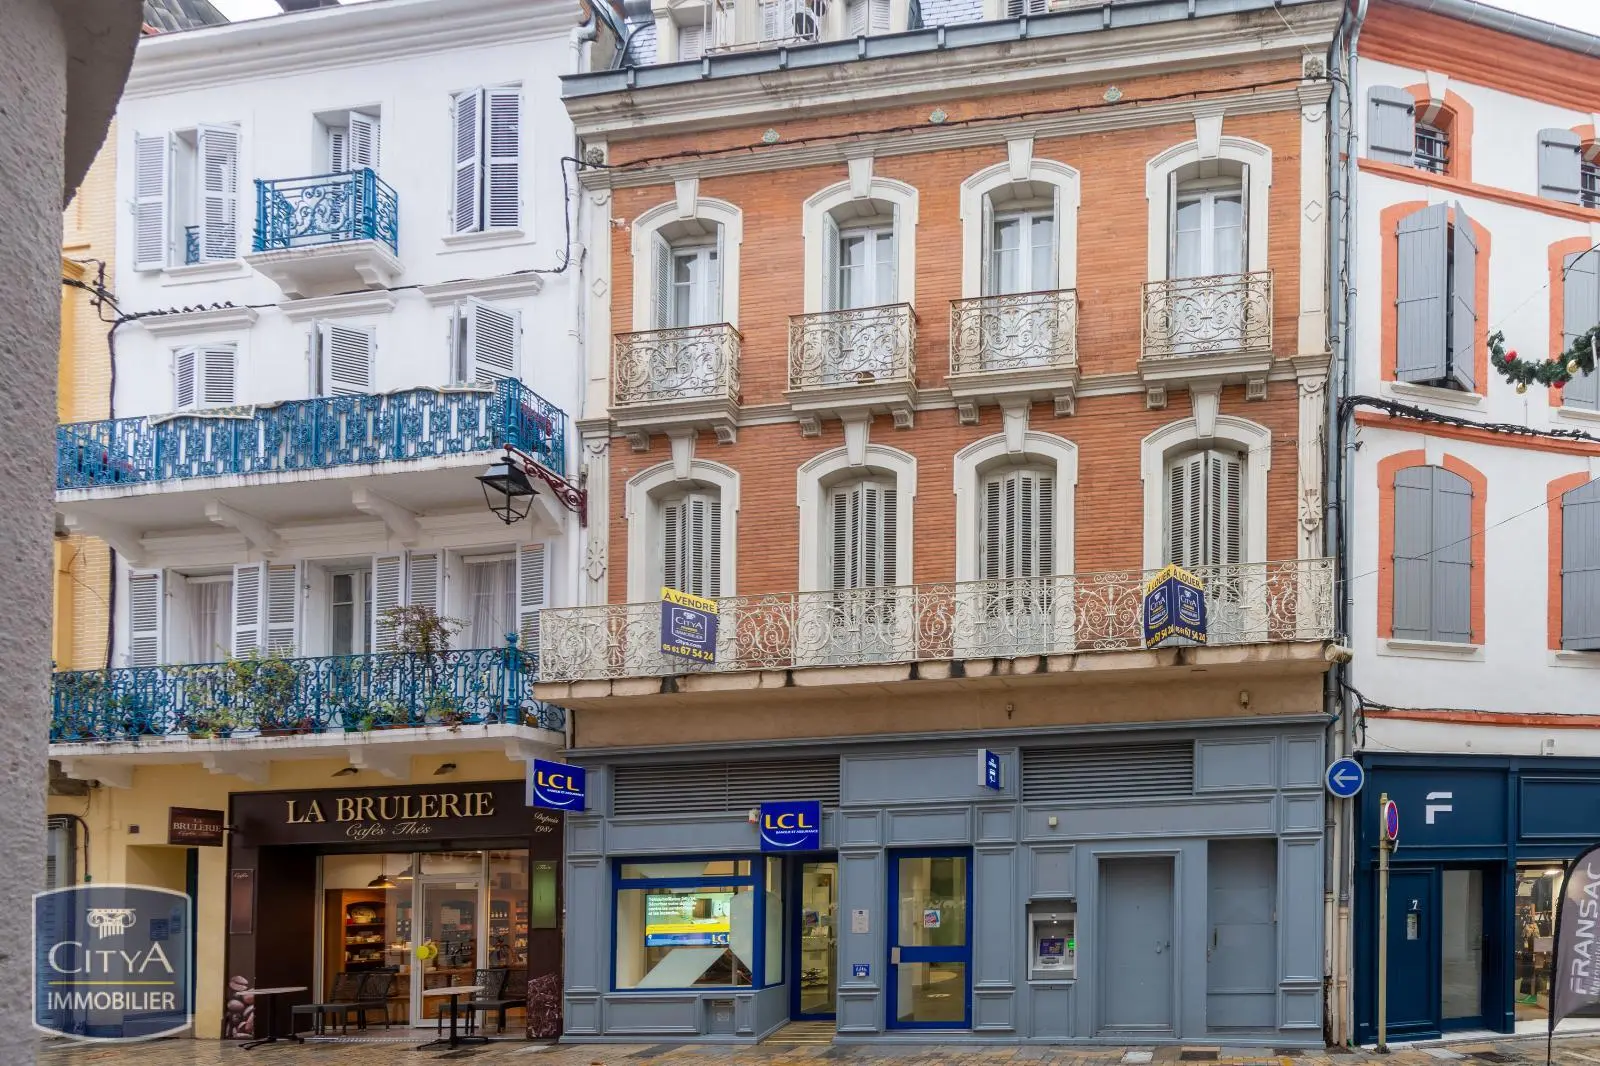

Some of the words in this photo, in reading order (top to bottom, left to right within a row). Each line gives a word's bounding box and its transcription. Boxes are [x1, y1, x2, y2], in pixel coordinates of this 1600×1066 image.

[1179, 571, 1200, 588] LOUER
[674, 595, 716, 612] VENDRE
[680, 646, 690, 656] 67
[692, 649, 702, 659] 54
[704, 651, 714, 661] 24
[538, 771, 580, 791] LCL
[285, 799, 326, 824] LA
[336, 792, 494, 822] BRULERIE
[1426, 792, 1452, 824] F
[172, 822, 222, 832] BRULERIE
[765, 813, 812, 829] LCL
[346, 822, 387, 840] Cafés
[392, 822, 432, 835] Thés
[1412, 900, 1418, 910] 7
